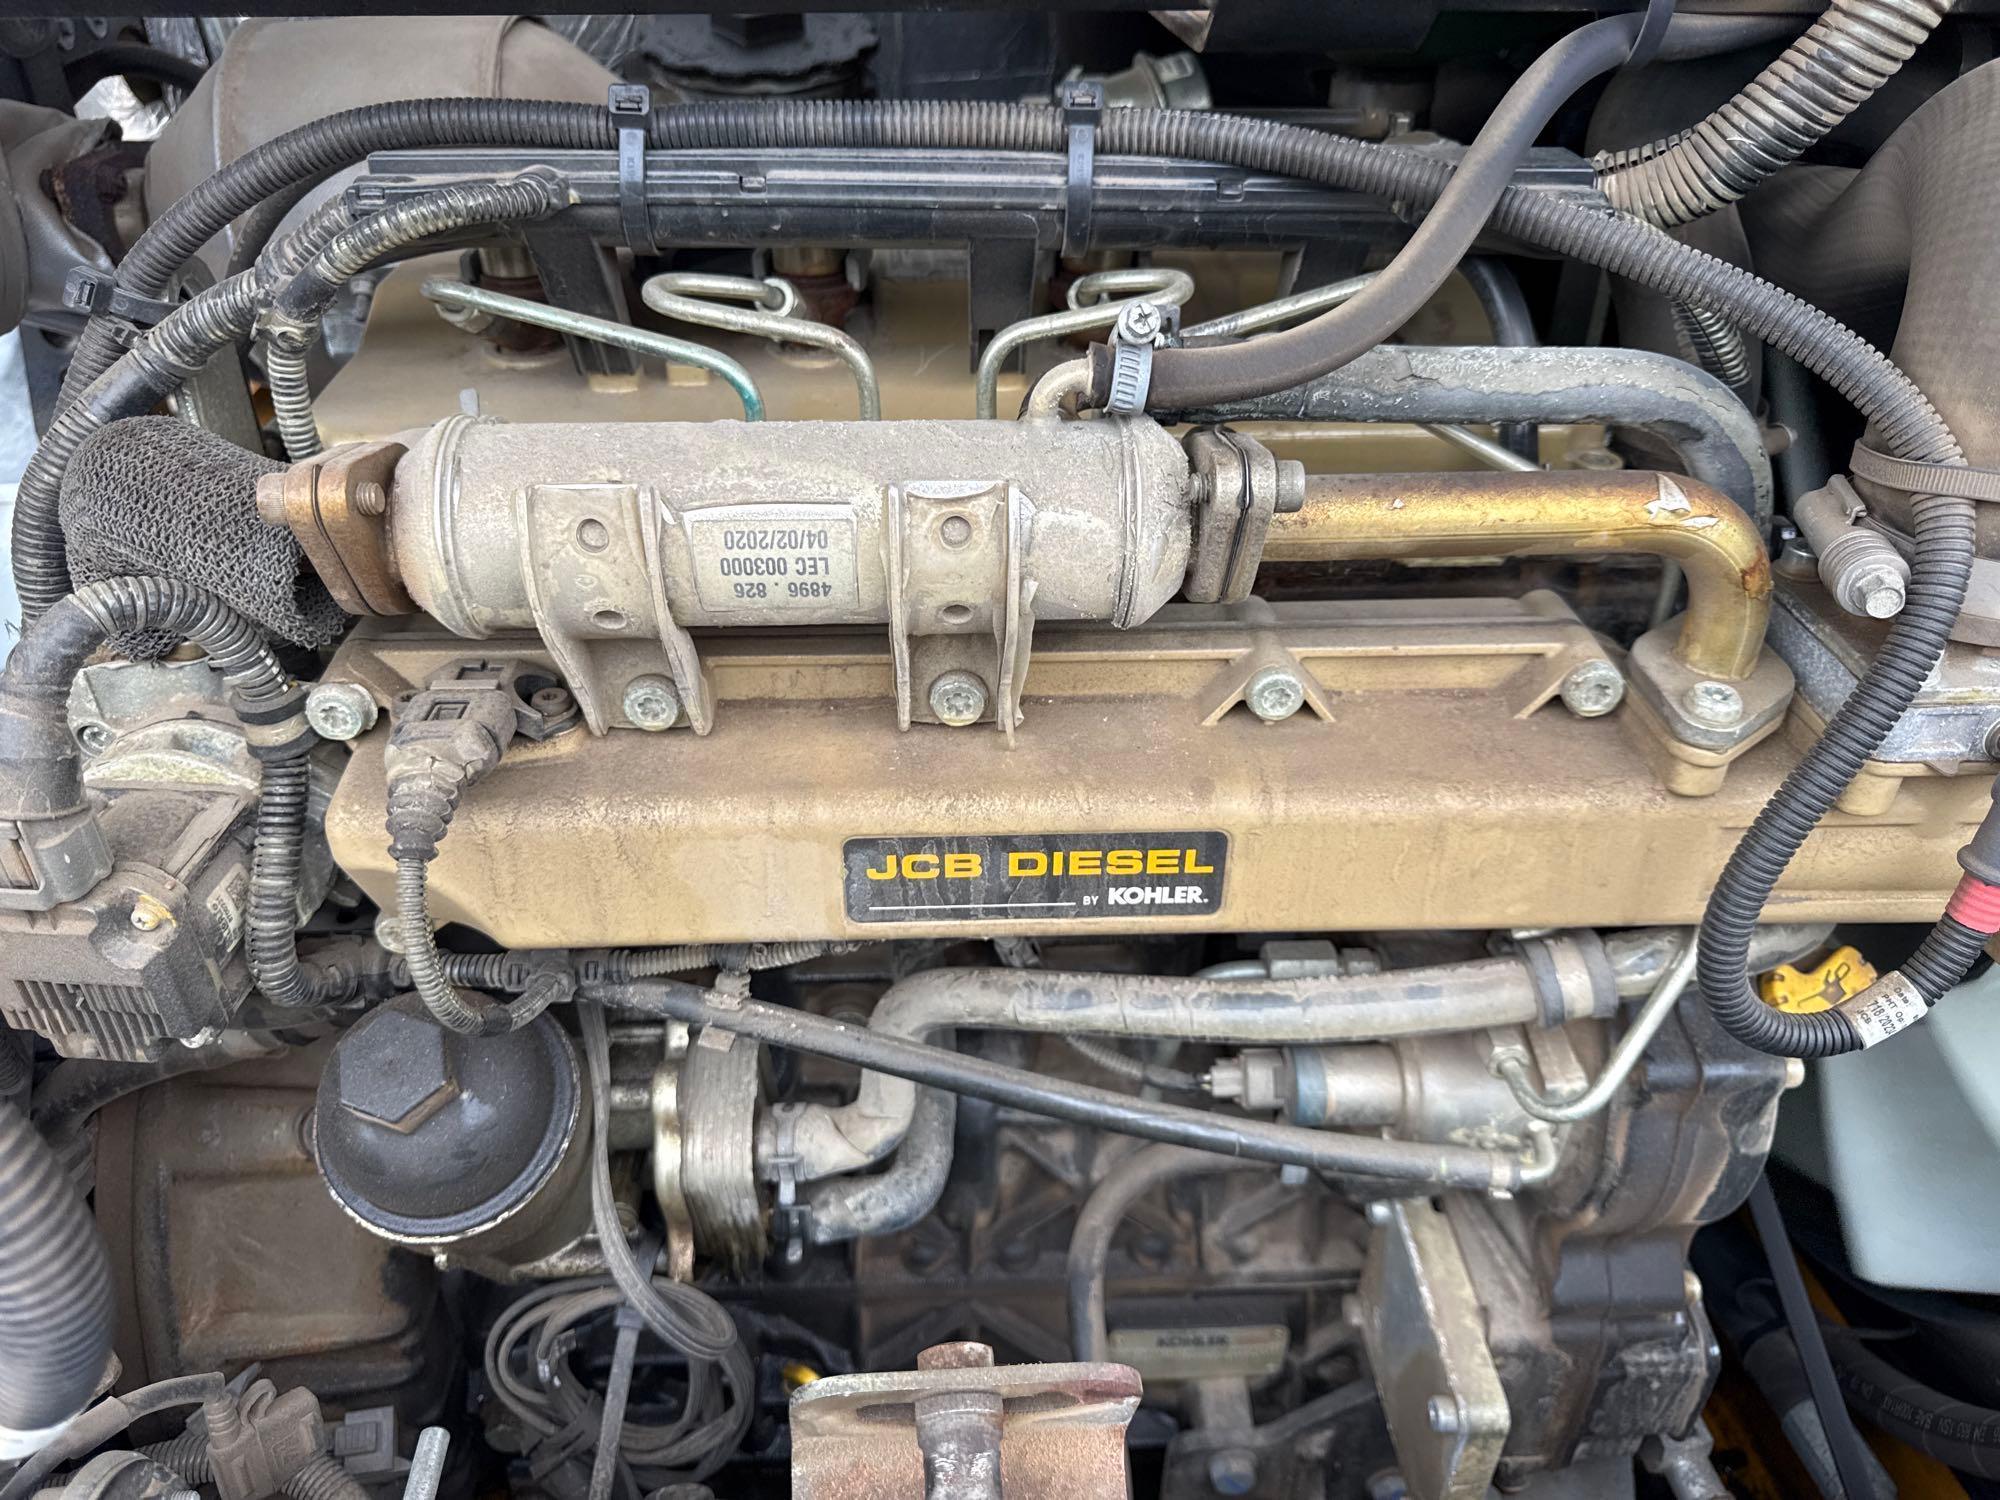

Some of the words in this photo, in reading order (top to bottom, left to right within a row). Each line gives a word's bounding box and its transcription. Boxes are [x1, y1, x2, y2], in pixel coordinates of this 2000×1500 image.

[724, 529, 828, 550] 04/02/2020
[720, 557, 787, 576] 003000
[795, 557, 830, 576] LEC
[733, 582, 767, 598] 826
[788, 582, 832, 598] 4896
[866, 853, 983, 880] JCB
[1008, 849, 1214, 877] DIESEL
[1083, 895, 1099, 906] BY
[1857, 1009, 1872, 1024] JCB
